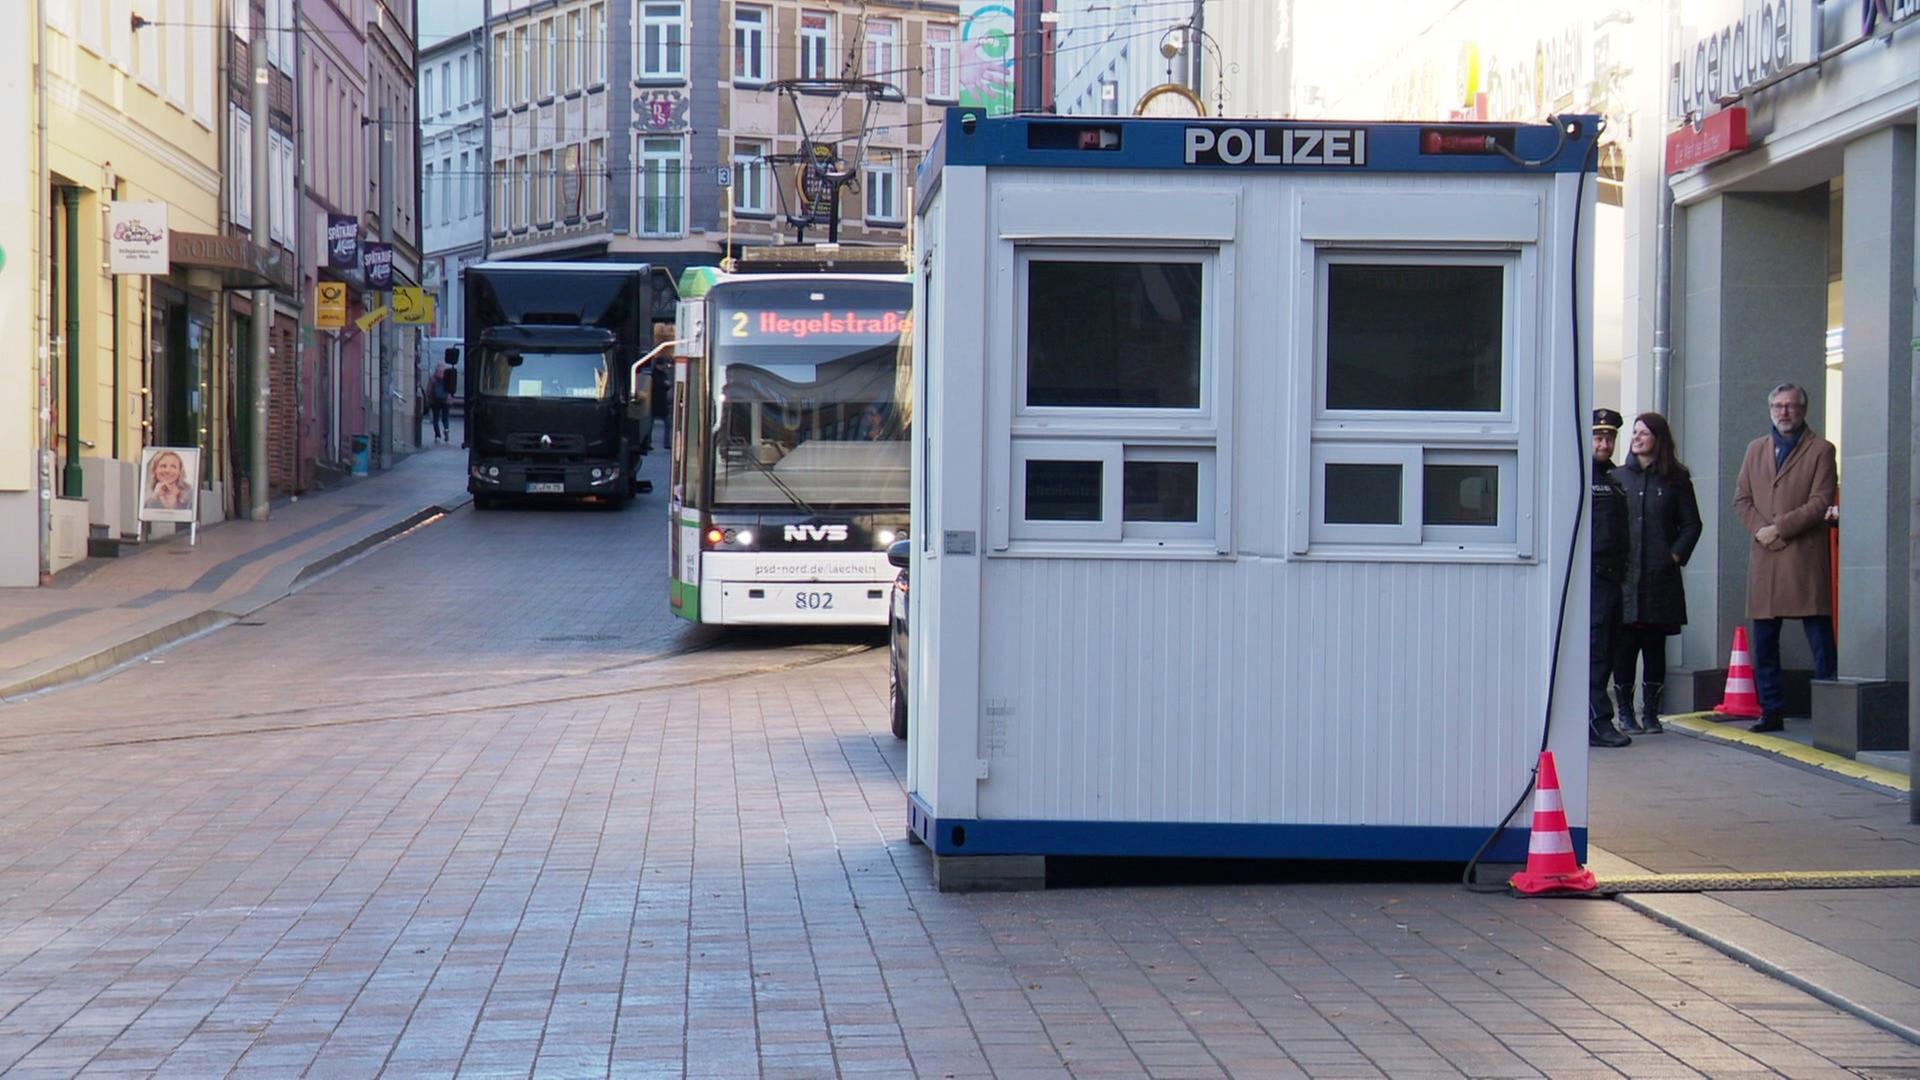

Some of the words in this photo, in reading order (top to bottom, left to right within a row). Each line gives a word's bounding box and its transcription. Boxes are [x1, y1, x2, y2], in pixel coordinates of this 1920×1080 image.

[1185, 128, 1365, 165] POLIZEI
[328, 223, 357, 241] SPÄTKAUF
[364, 250, 392, 267] SPÄTKAUF
[732, 311, 749, 337] 2
[759, 311, 912, 338] Hegelstraße
[784, 524, 849, 542] NVS
[755, 565, 877, 575] psd-nord.de/laecheln
[795, 592, 833, 609] 802
